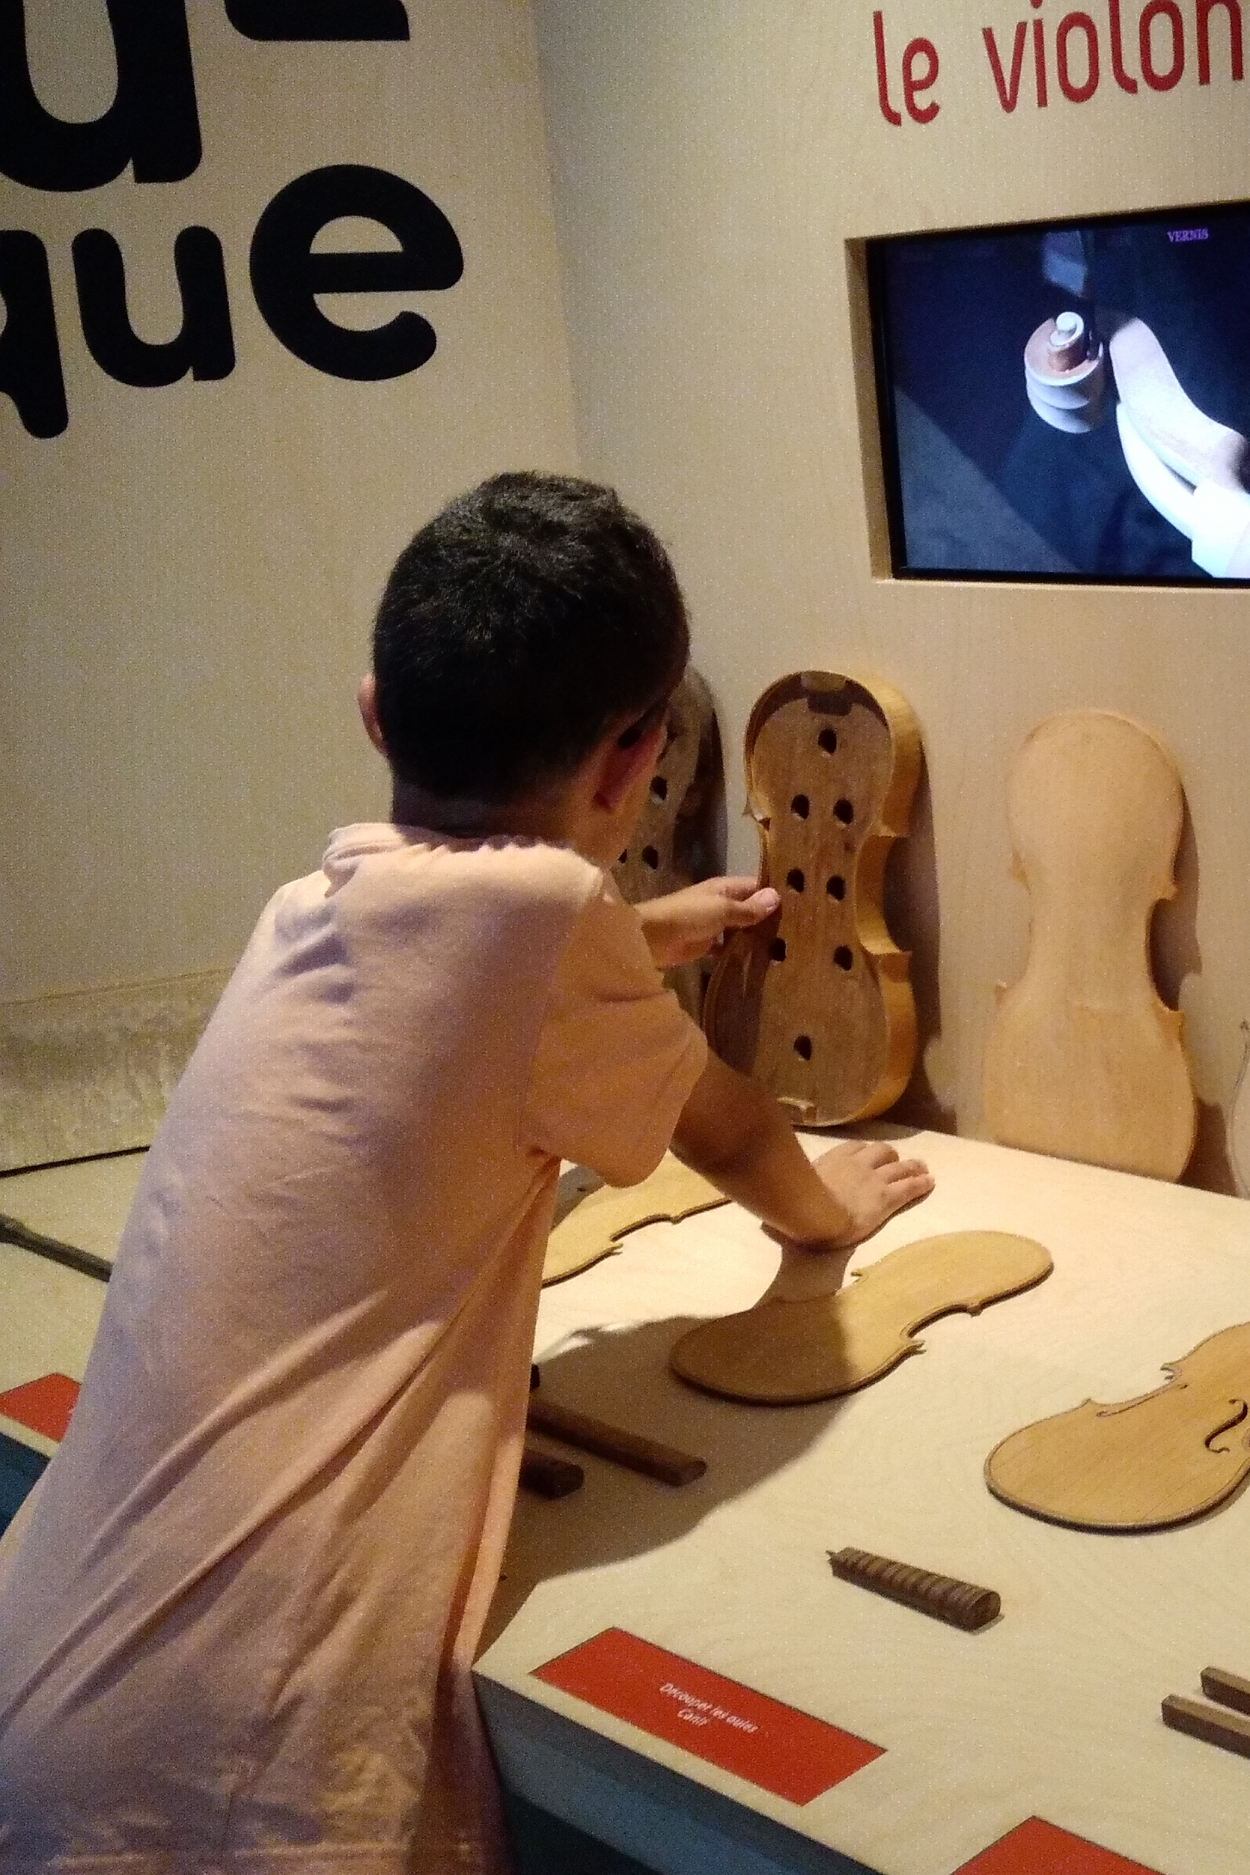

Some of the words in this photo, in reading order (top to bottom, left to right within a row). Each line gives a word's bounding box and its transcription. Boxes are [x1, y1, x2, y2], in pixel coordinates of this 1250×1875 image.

[873, 10, 940, 127] le
[982, 0, 1244, 113] violon
[1167, 228, 1209, 242] VERNIS
